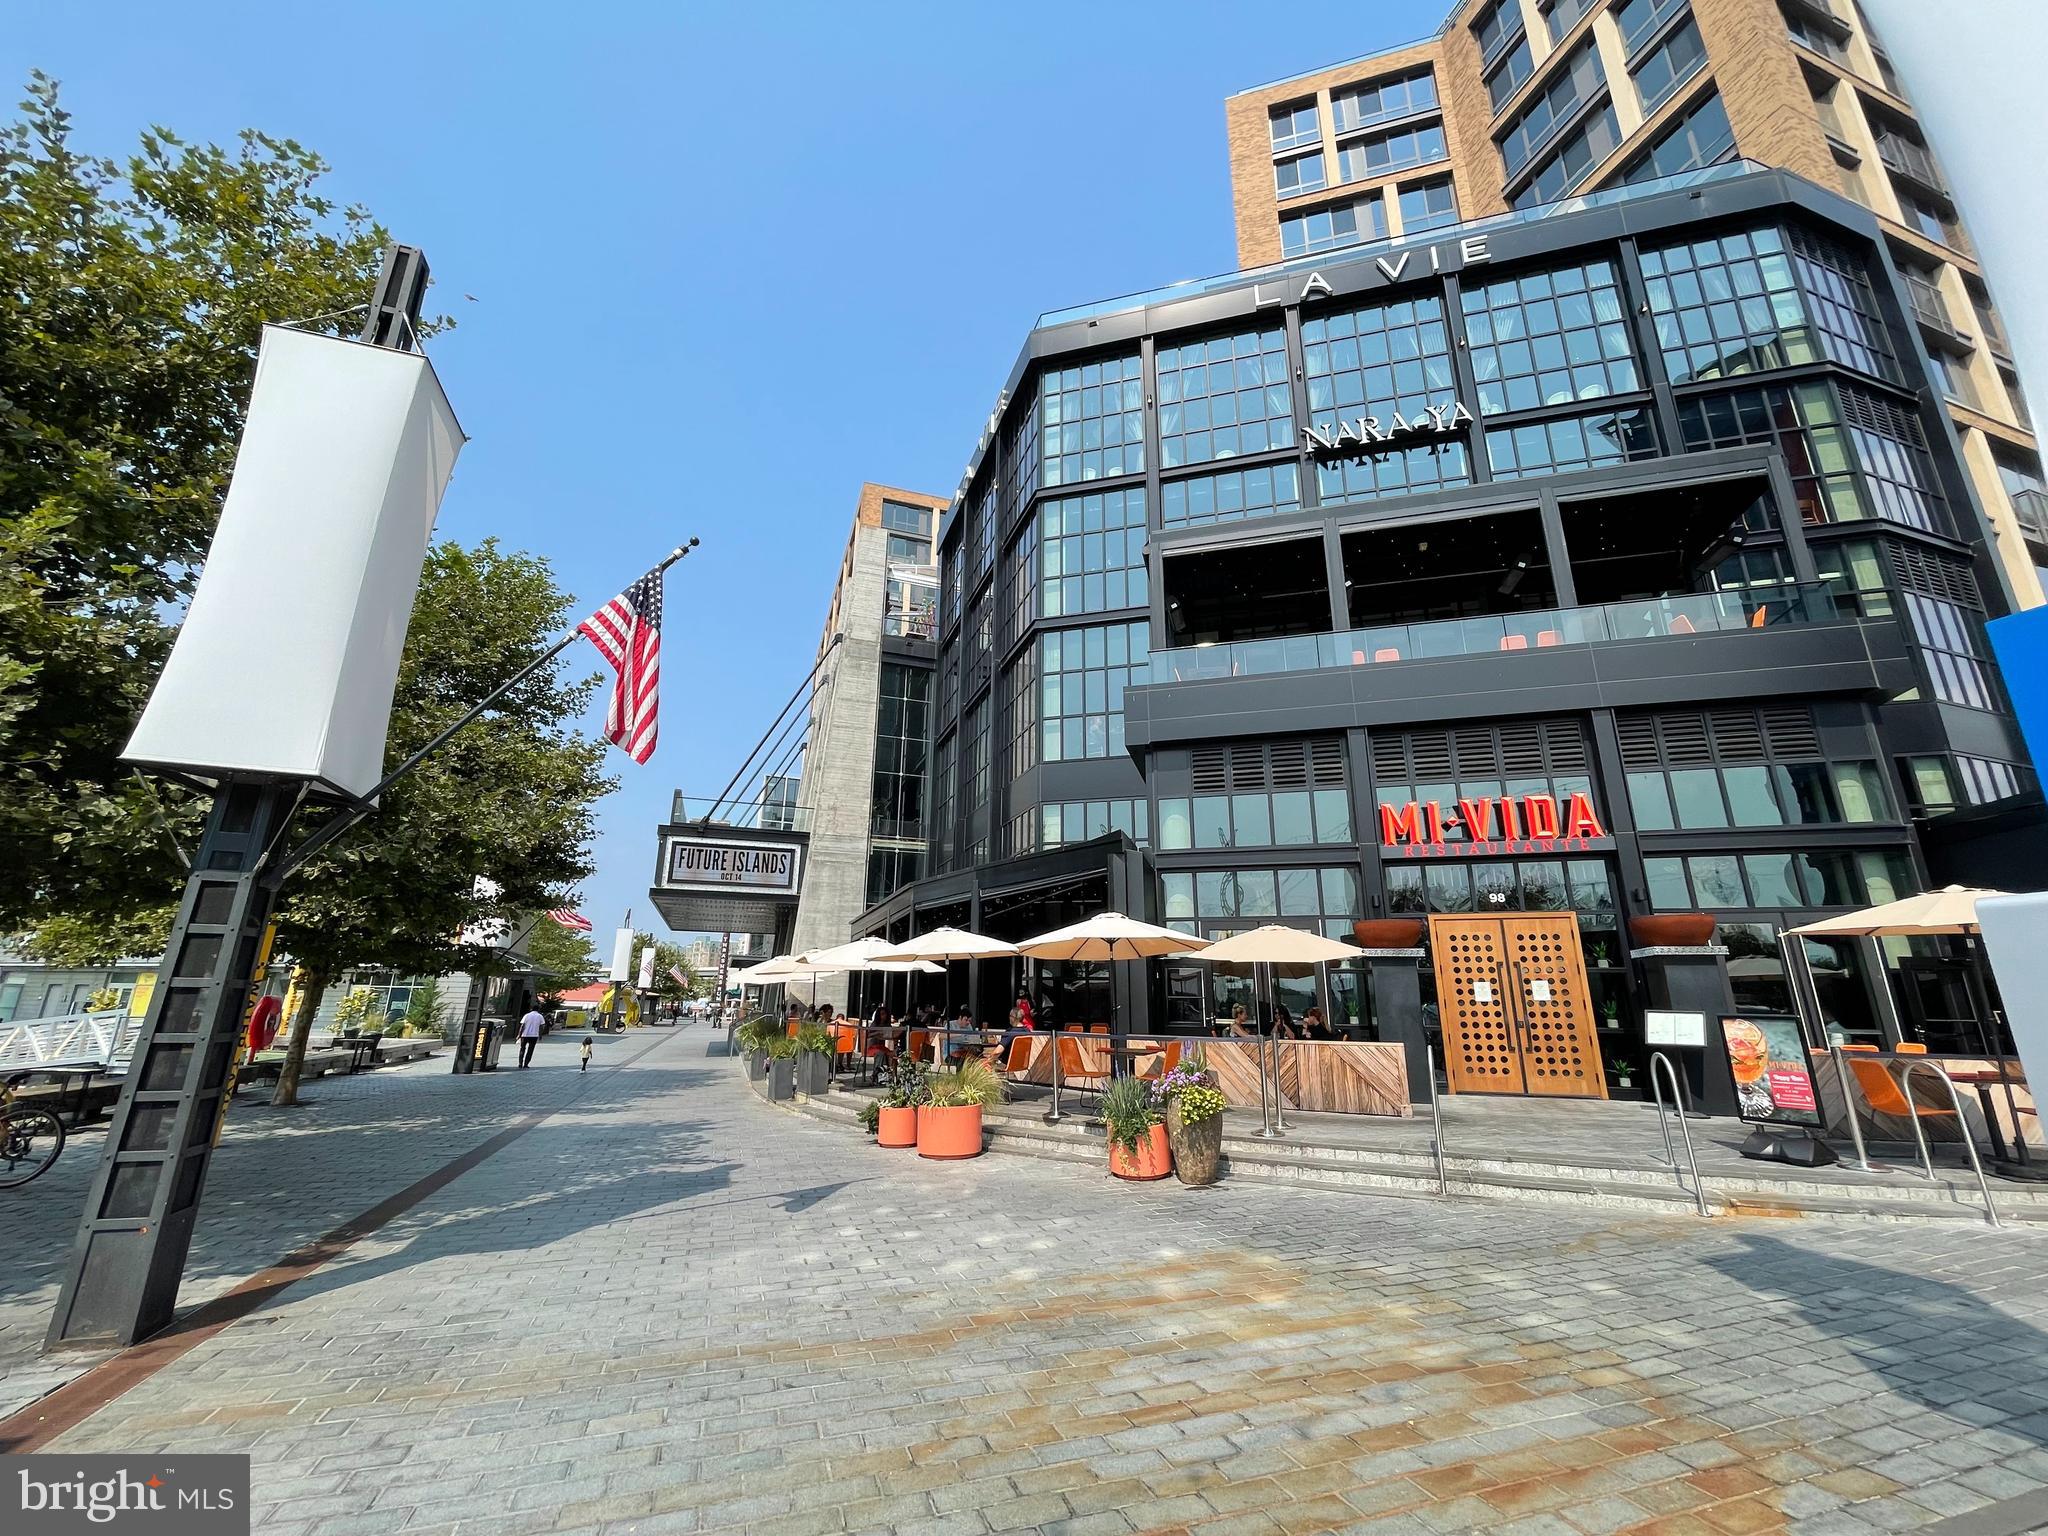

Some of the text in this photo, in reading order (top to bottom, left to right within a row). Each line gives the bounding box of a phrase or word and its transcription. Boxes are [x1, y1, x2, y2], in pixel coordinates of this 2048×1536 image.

[1253, 235, 1492, 309] LA VIE
[1404, 839, 1592, 857] RESTAURANTE
[678, 847, 787, 874] FUTURE ISLANDS
[720, 872, 742, 881] OCT 14
[1489, 893, 1506, 903] 98
